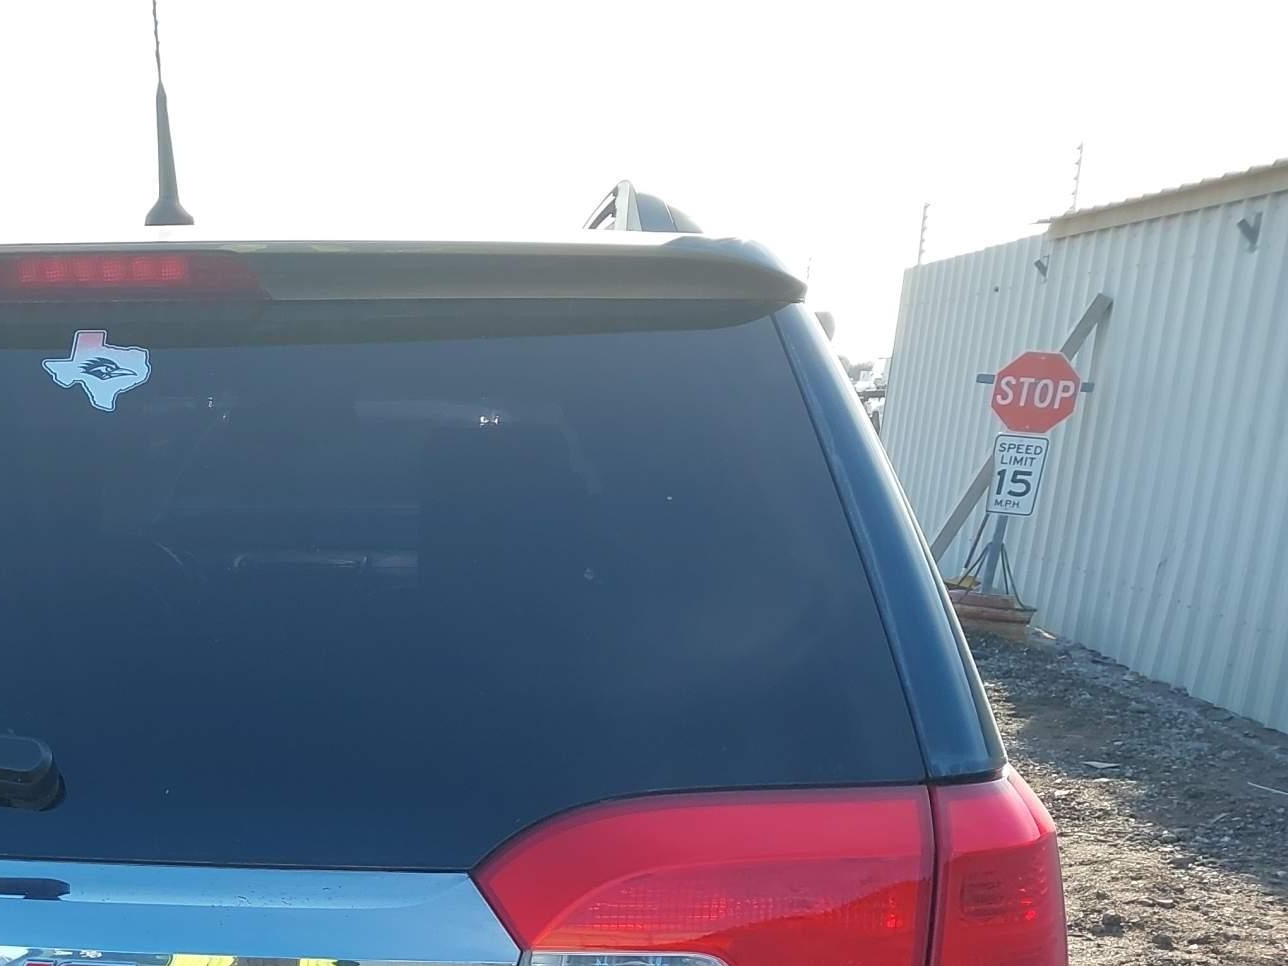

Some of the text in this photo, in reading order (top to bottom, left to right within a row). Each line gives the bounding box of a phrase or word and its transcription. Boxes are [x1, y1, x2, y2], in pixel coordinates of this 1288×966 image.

[996, 376, 1076, 409] STOP
[998, 442, 1043, 456] SPEED
[1000, 455, 1036, 467] LIMIT
[995, 469, 1033, 497] 15
